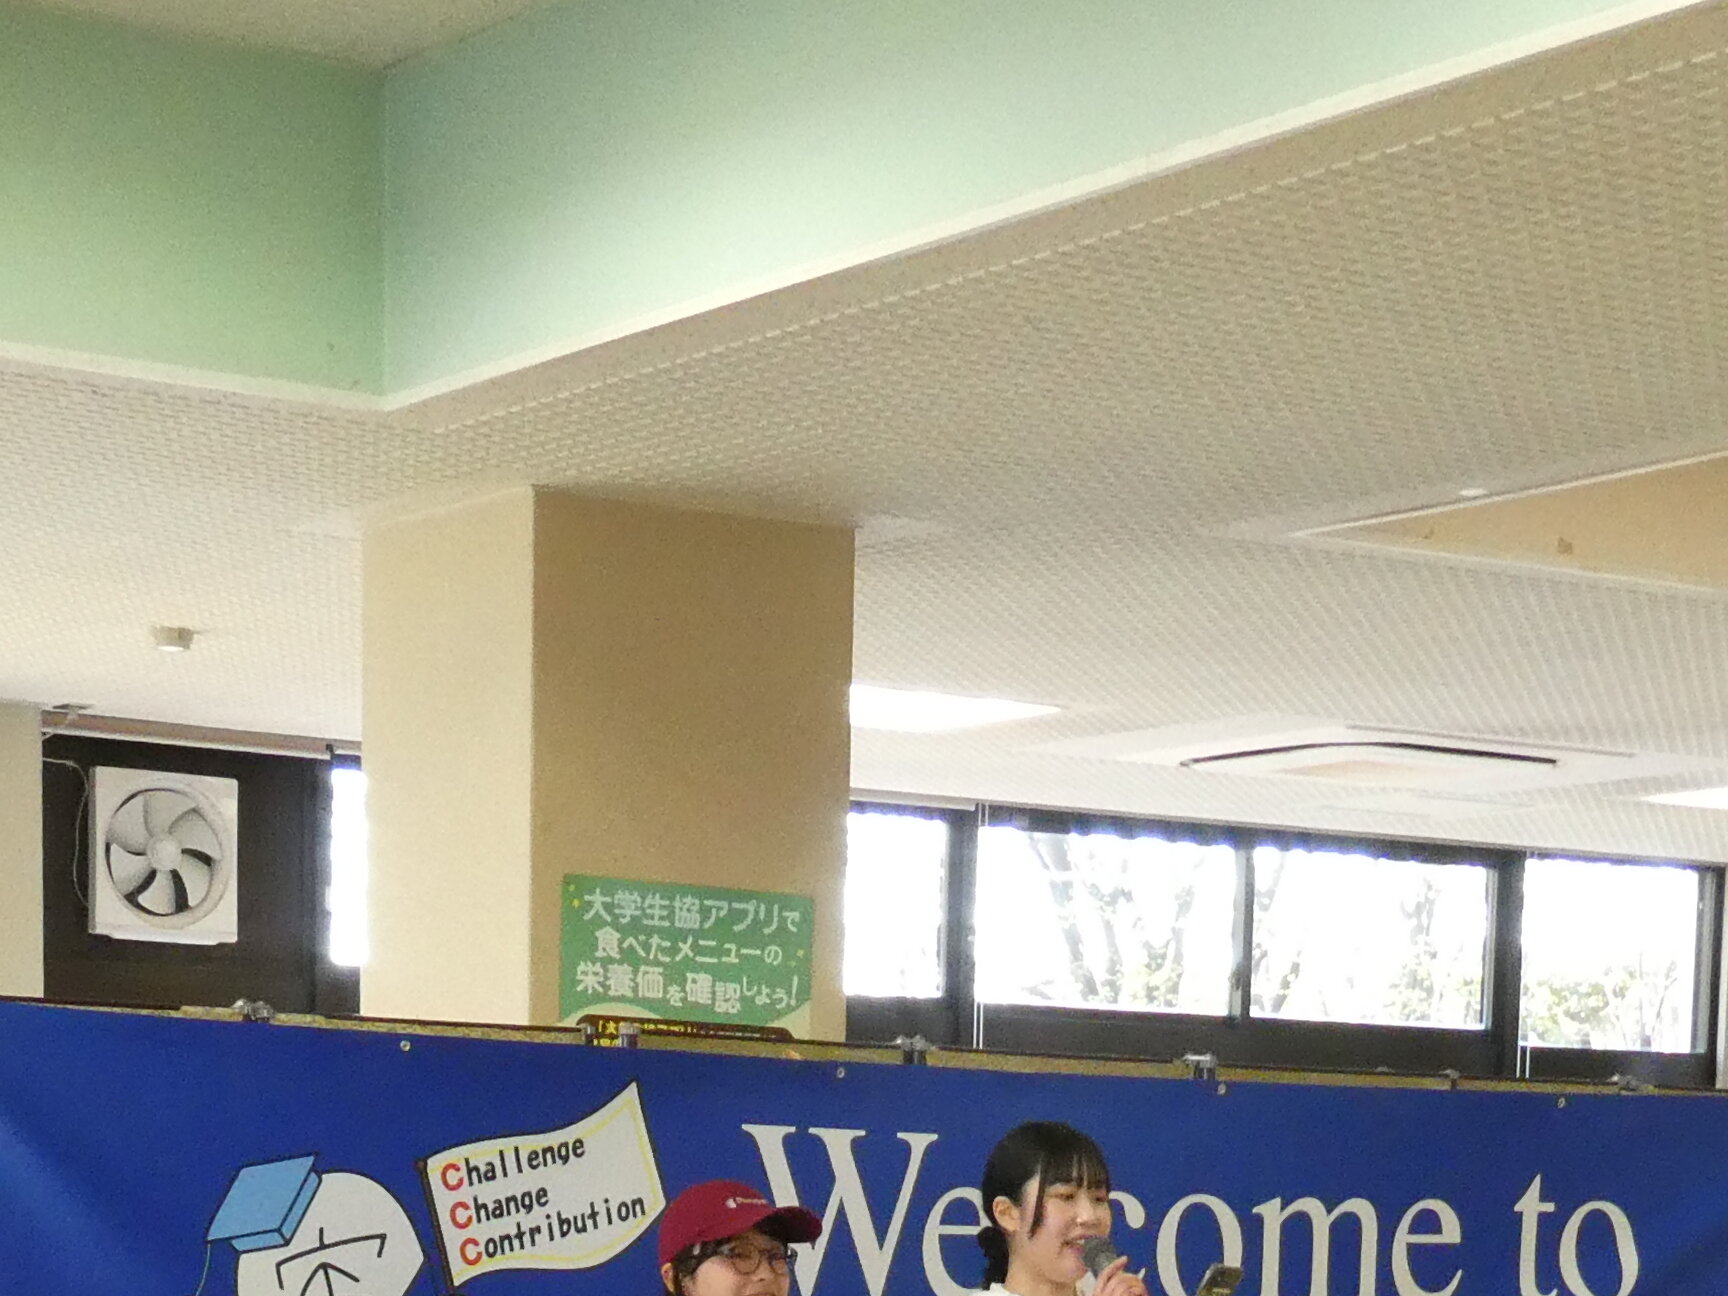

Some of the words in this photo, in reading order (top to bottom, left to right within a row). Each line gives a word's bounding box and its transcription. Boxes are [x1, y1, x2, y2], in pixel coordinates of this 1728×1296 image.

[582, 887, 800, 934] 大学生協アプリで
[594, 925, 783, 967] 食べたメニューの
[575, 960, 799, 1014] 栄養価を確認しよう!
[440, 1137, 586, 1192] Challenge
[449, 1186, 549, 1230] Change
[459, 1196, 647, 1266] Contribution
